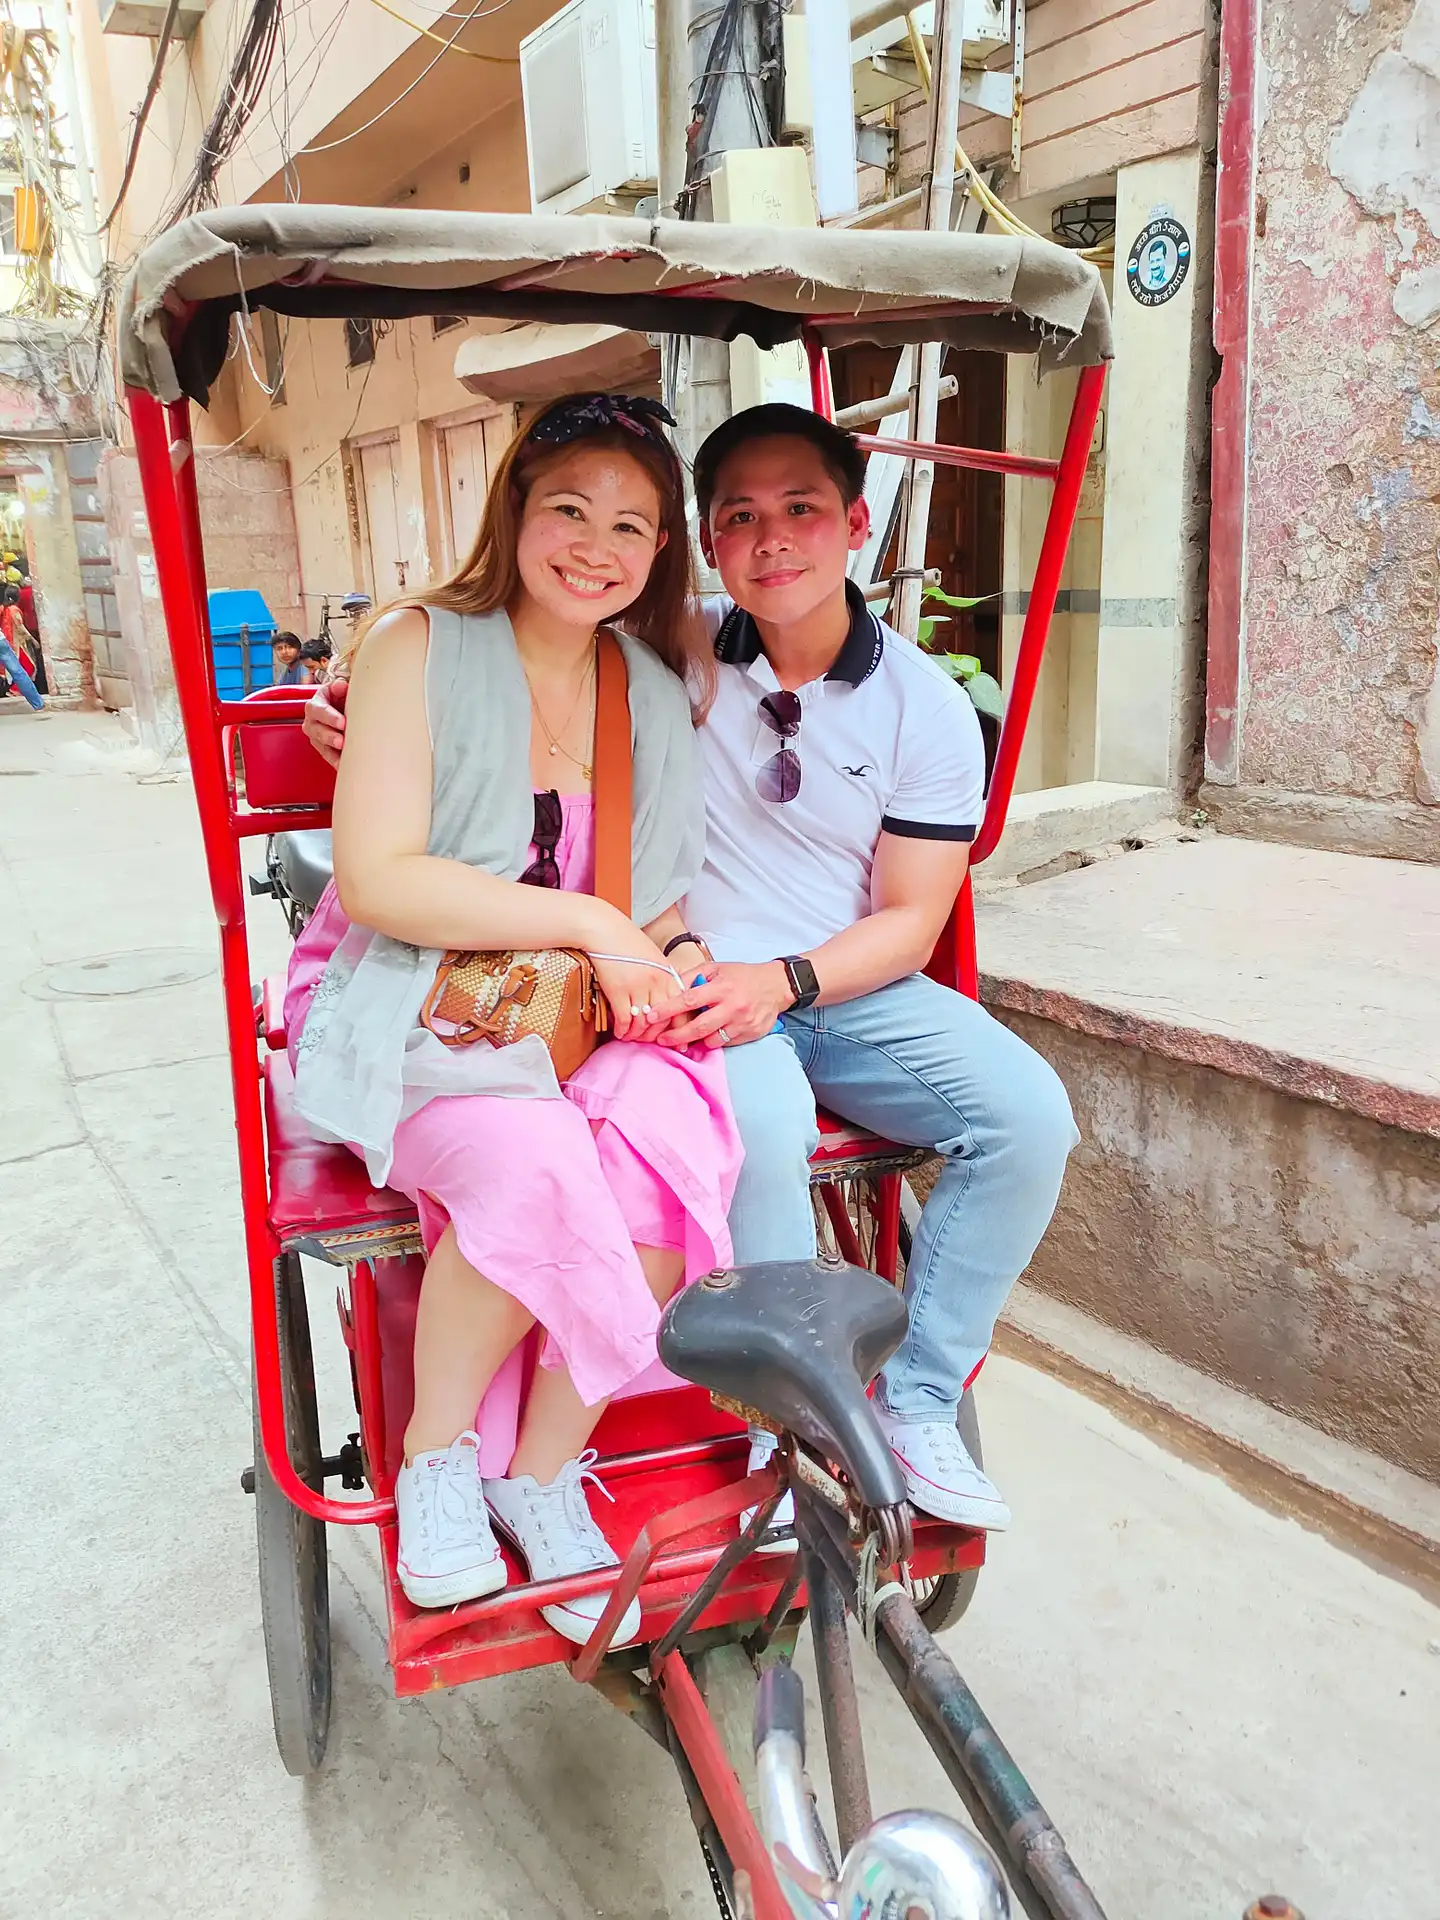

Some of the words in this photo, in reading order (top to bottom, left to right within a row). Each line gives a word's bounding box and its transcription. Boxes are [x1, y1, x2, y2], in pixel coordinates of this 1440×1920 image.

[1135, 231, 1149, 252] अच्छे
[1149, 221, 1162, 235] बीते
[1163, 221, 1169, 231] 5
[1167, 224, 1182, 239] साल
[1130, 278, 1142, 296] लगे
[1140, 291, 1152, 304] रहो
[1153, 264, 1186, 303] केजरीवाल
